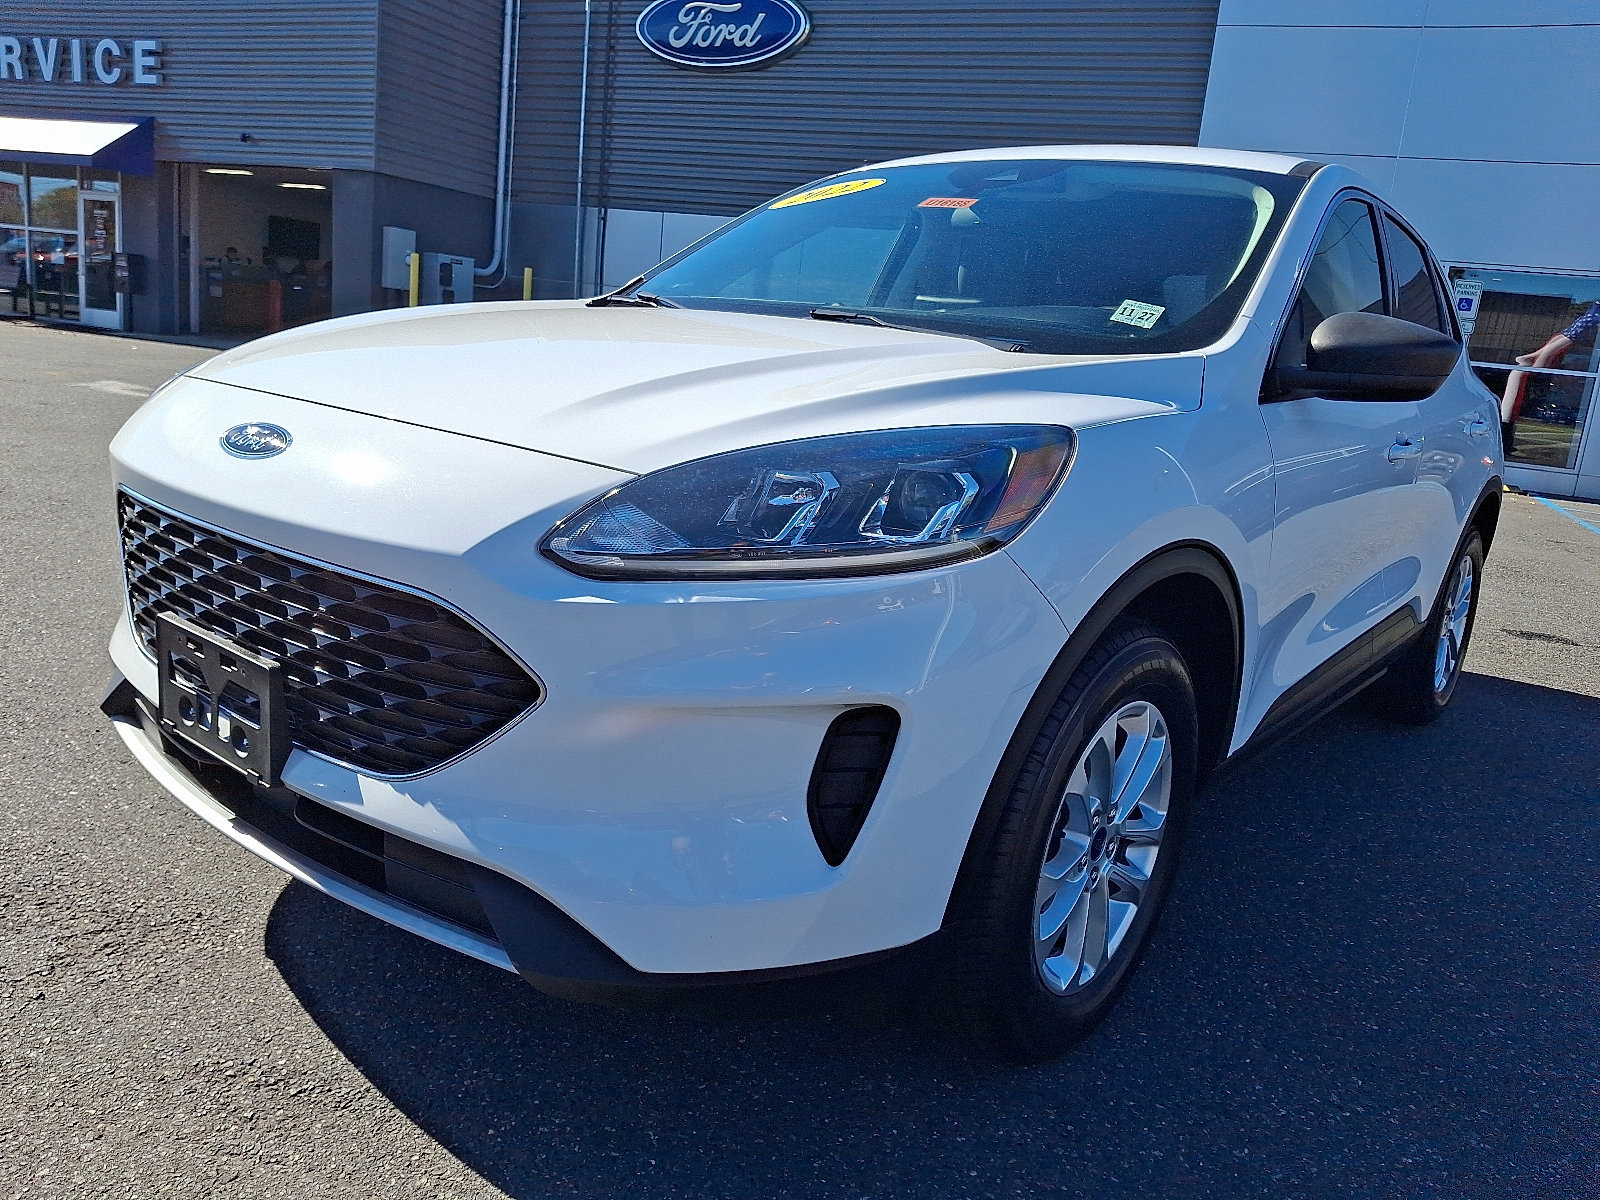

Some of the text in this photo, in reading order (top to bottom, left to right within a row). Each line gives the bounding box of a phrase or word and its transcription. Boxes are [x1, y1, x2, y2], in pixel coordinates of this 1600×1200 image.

[668, 2, 767, 49] Ford
[1119, 306, 1135, 317] 11
[1138, 311, 1156, 321] 27
